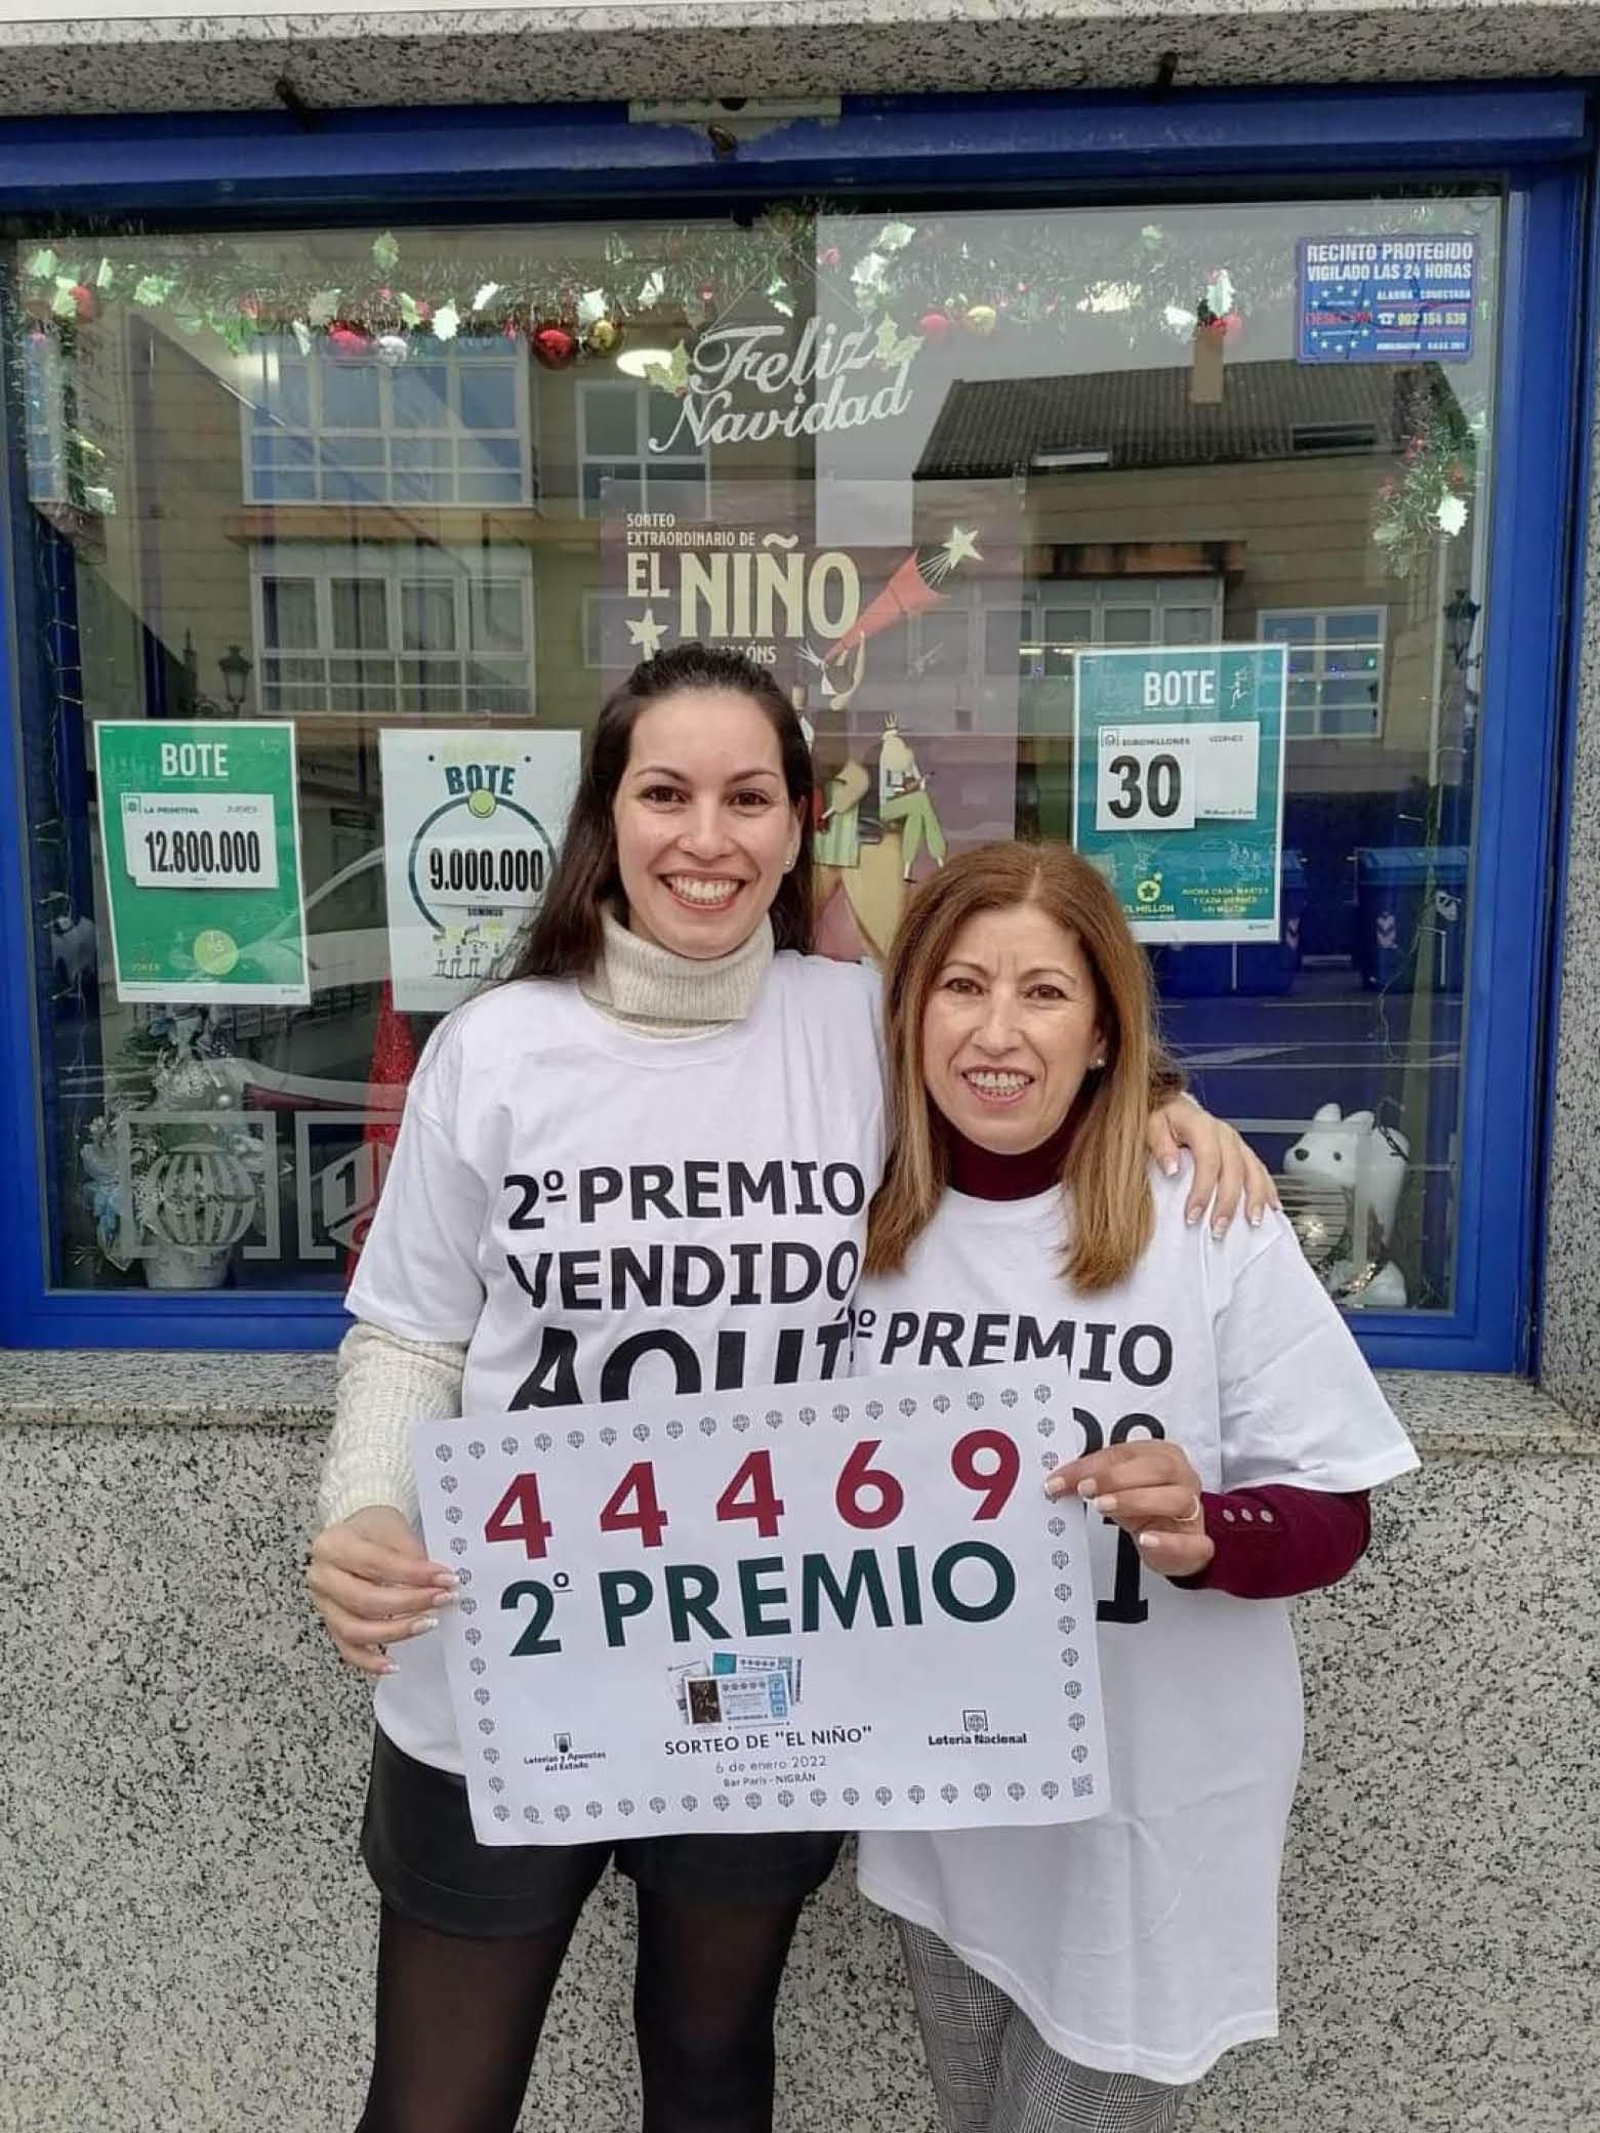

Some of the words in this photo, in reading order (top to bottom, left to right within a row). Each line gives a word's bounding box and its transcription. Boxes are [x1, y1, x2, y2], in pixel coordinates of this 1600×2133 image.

[1307, 244, 1377, 263] RECINTO
[1381, 241, 1473, 260] PROTEGIDO
[1307, 264, 1370, 281] VIGILADO
[1373, 264, 1399, 279] LAS
[1403, 263, 1420, 279] 24
[1425, 263, 1472, 279] HORAS
[689, 316, 876, 394] Feliz
[648, 358, 914, 452] Navidad
[627, 513, 676, 527] SORTEO
[627, 531, 735, 546] EXTRAORDINARIO
[740, 531, 755, 546] DE
[627, 552, 670, 597] EL
[679, 533, 860, 639] NIÑO
[1144, 670, 1215, 705] BOTE
[160, 742, 229, 777] BOTE
[444, 764, 516, 796] BOTE
[1107, 753, 1182, 819] 30
[144, 830, 260, 873] 12.800.000
[429, 847, 543, 892] 9.000.000
[579, 1160, 866, 1224] PREMIO
[506, 1240, 860, 1311] VENDIDO
[880, 1311, 1173, 1387] PREMIO
[500, 1571, 575, 1658] 2º
[598, 1540, 1017, 1648] PREMIO
[664, 1736, 739, 1756] SORTEO
[746, 1733, 770, 1750] DE
[775, 1730, 805, 1747] "EL
[811, 1725, 872, 1745] NIÑO"
[974, 1732, 1027, 1745] Nacional
[715, 1762, 724, 1774] 6
[728, 1762, 746, 1773] de
[750, 1761, 787, 1771] enero
[791, 1755, 827, 1769] 2022
[723, 1778, 740, 1787] Bar
